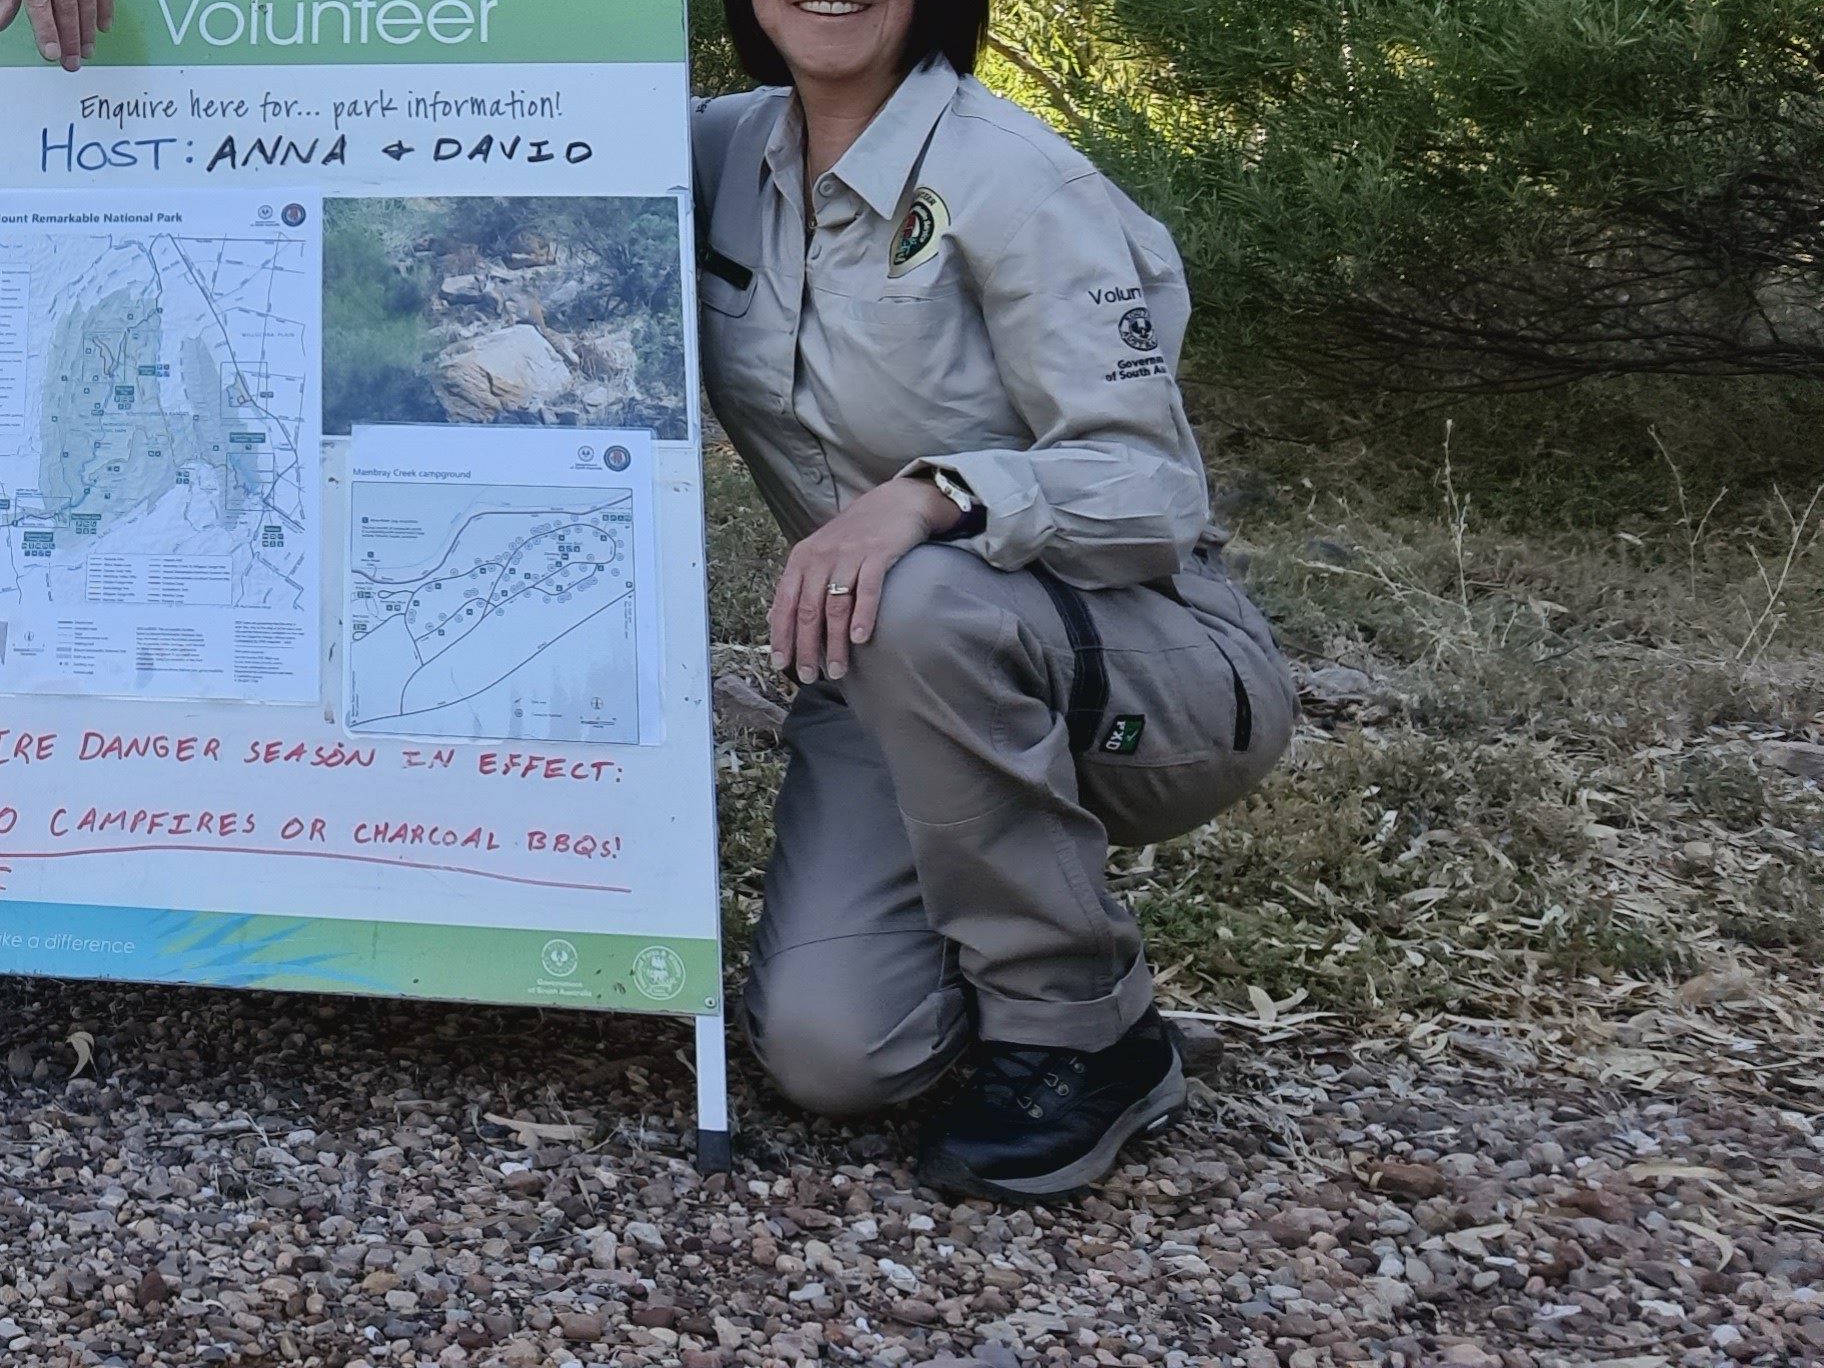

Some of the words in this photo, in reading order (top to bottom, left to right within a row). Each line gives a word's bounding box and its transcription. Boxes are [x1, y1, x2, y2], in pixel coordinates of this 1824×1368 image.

[79, 91, 178, 130] Enquire
[189, 88, 249, 119] here
[332, 88, 398, 131] park
[407, 89, 564, 123] information!
[205, 133, 347, 173] ANNA
[433, 133, 593, 164] DAVID
[32, 212, 100, 224] Remarkable
[103, 212, 153, 223] National
[157, 212, 183, 223] Park
[1105, 720, 1126, 751] FXD
[78, 731, 221, 762] DANGER
[243, 741, 376, 768] SEASON
[402, 748, 455, 770] IN
[478, 753, 623, 783] EFFECT:
[49, 807, 256, 837] CAMPFIRES
[281, 817, 327, 843] OR
[353, 821, 501, 851] CHARCOAL
[27, 935, 40, 949] a
[44, 933, 136, 954] difference
